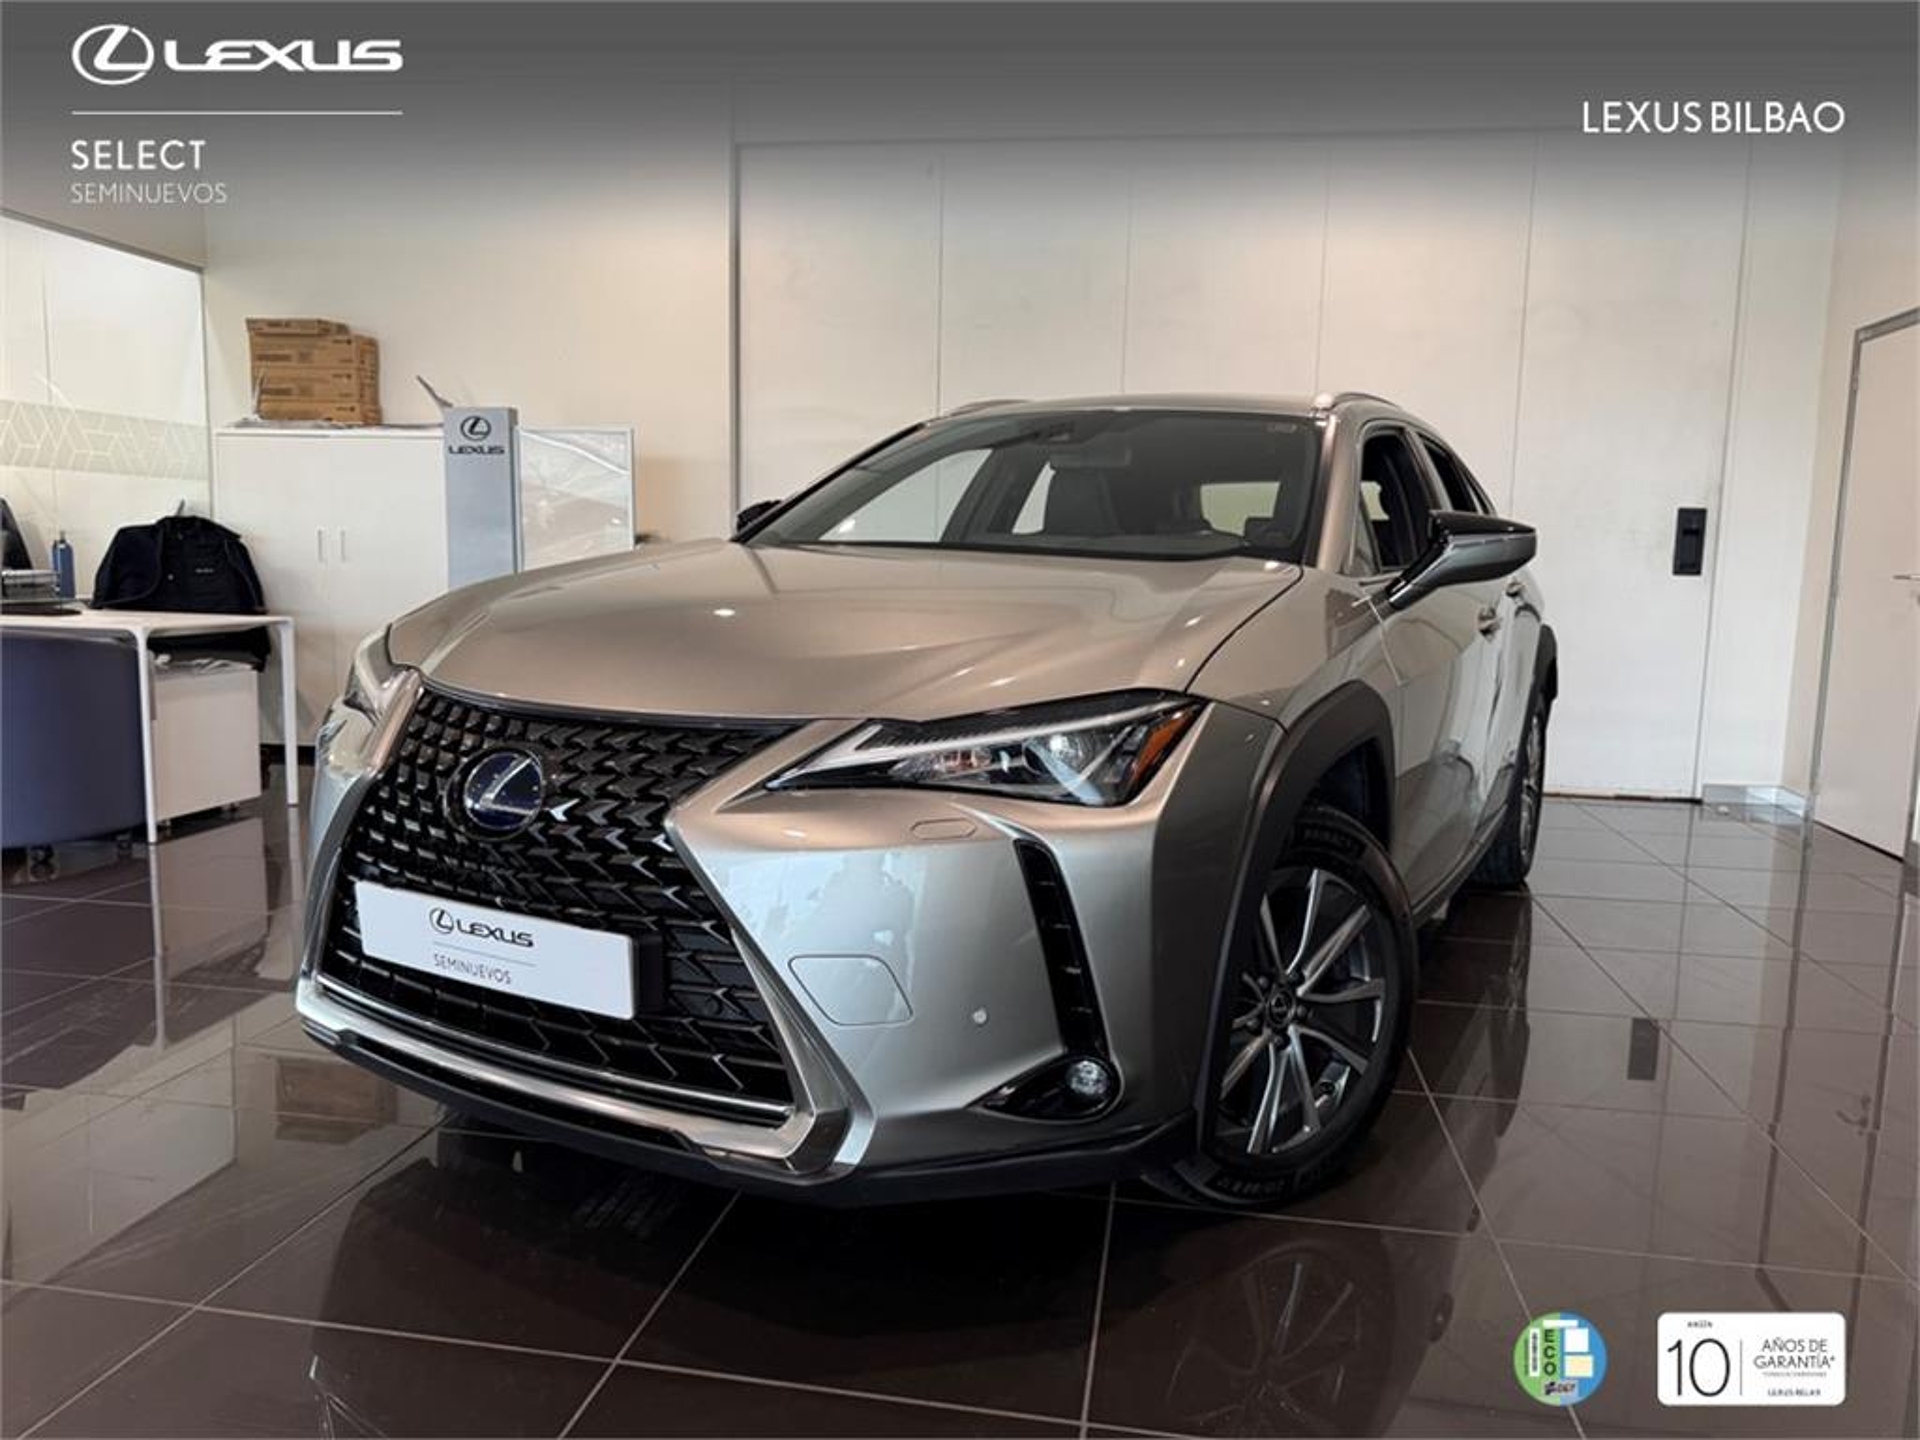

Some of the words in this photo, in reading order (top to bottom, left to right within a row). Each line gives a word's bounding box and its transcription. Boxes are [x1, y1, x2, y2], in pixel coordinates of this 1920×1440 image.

[448, 445, 505, 455] LEXUS
[456, 920, 535, 949] LEXUS
[433, 953, 512, 985] SEMINUEVOS
